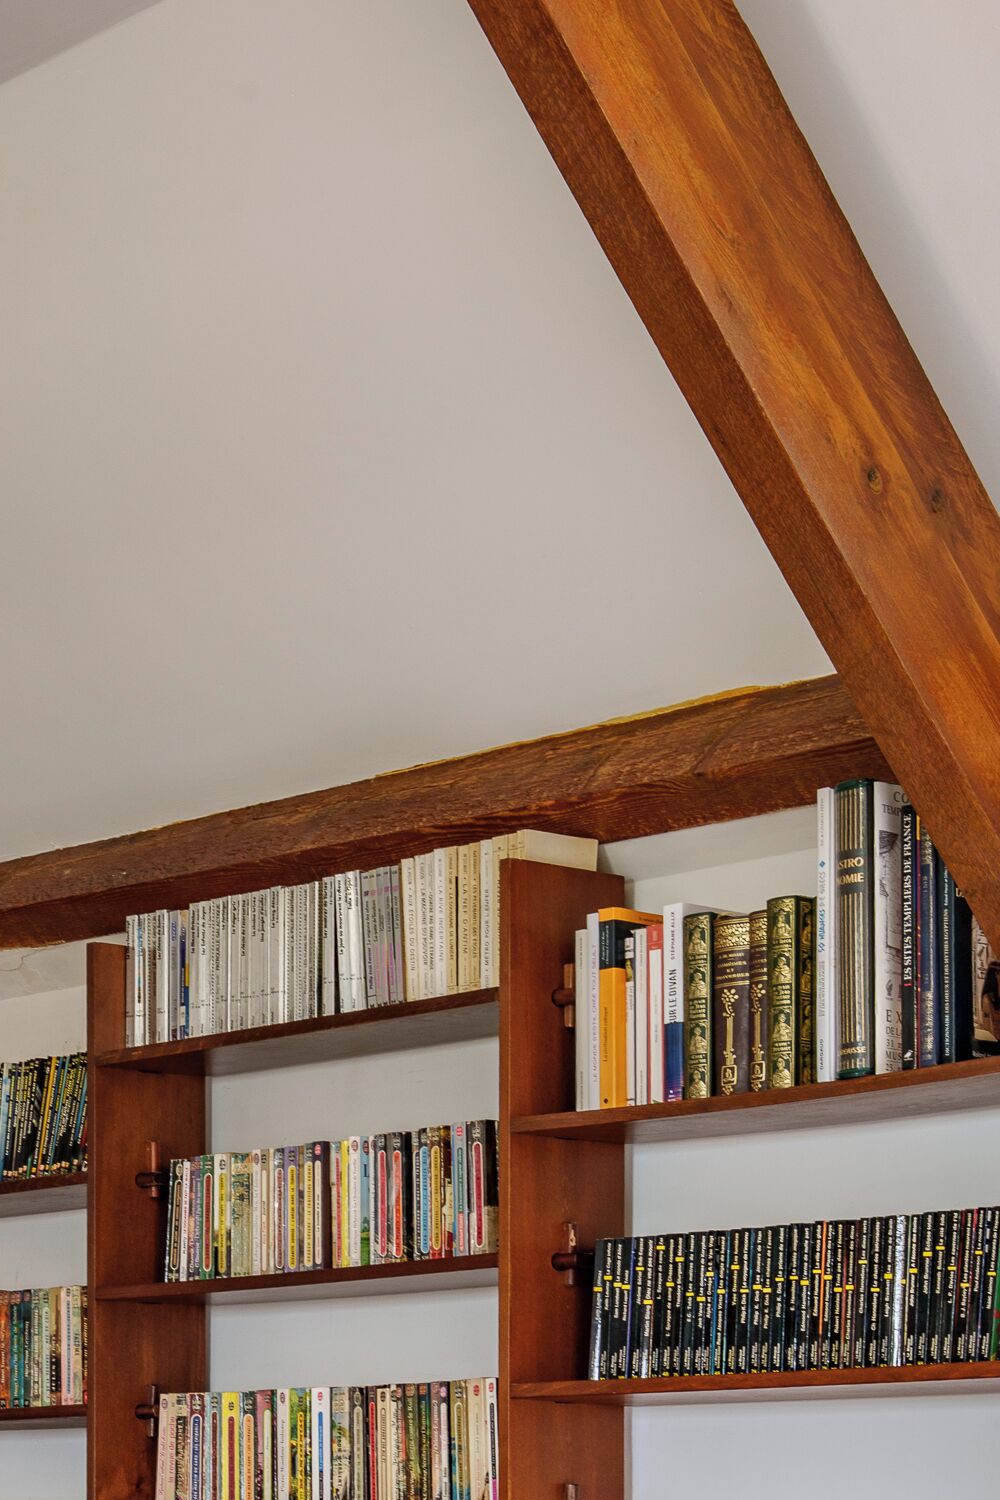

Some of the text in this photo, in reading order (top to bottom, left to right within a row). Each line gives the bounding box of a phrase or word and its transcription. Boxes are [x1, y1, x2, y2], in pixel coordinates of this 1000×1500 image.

[902, 814, 912, 987] LES SITES TEMPLIERS DE FRANCE
[669, 997, 677, 1007] LE
